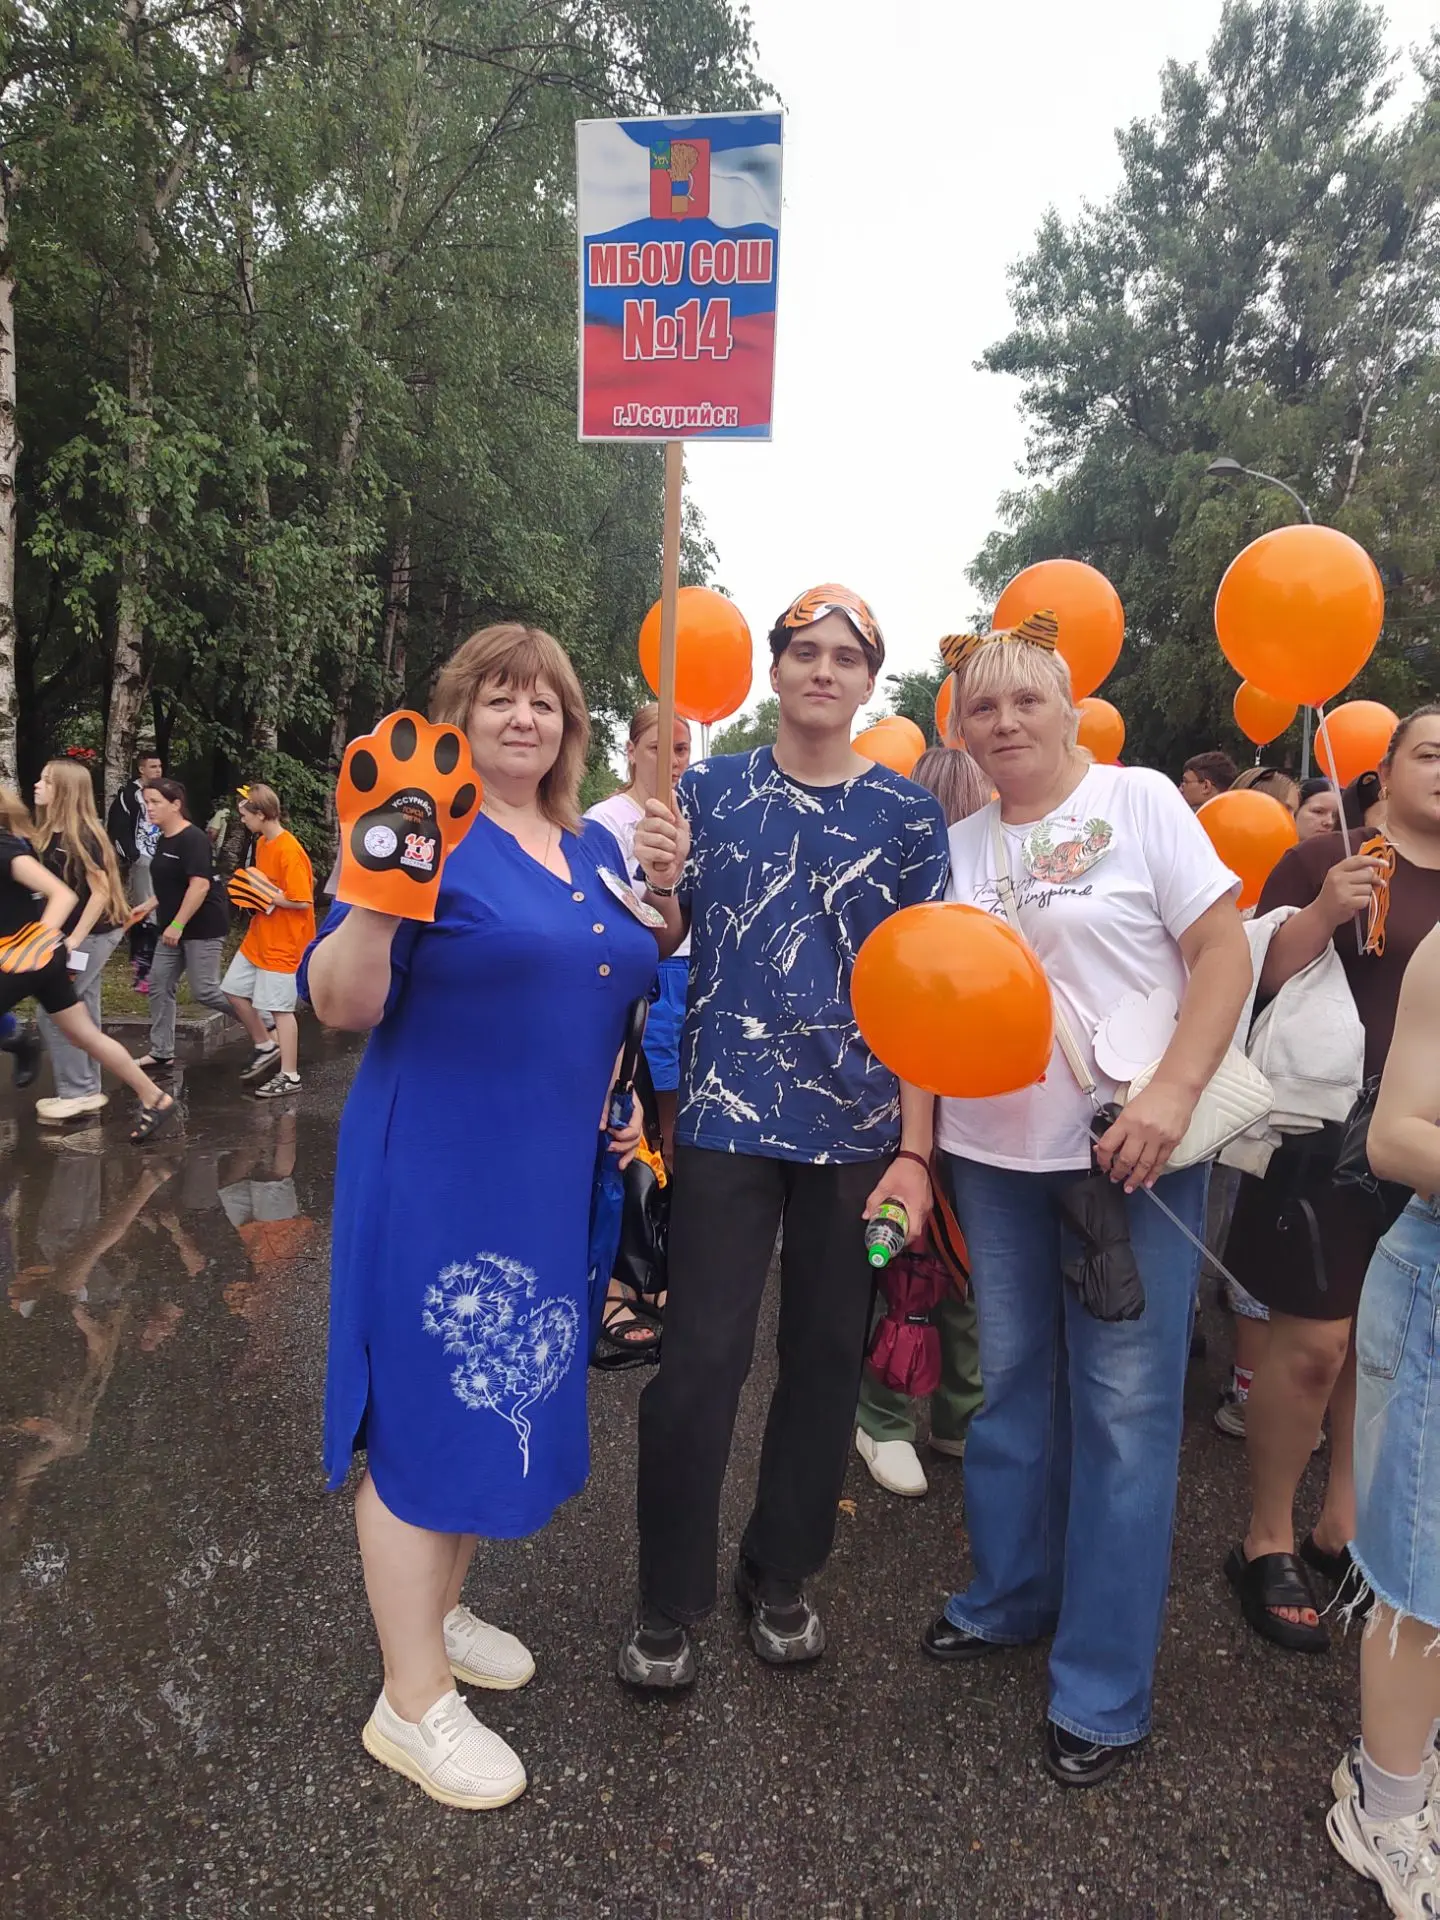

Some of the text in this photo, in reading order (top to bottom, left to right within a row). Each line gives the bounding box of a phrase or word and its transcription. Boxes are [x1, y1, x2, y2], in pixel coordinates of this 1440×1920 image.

[589, 239, 772, 286] МБОУ СОШ
[613, 403, 738, 427] г.Уссурийск
